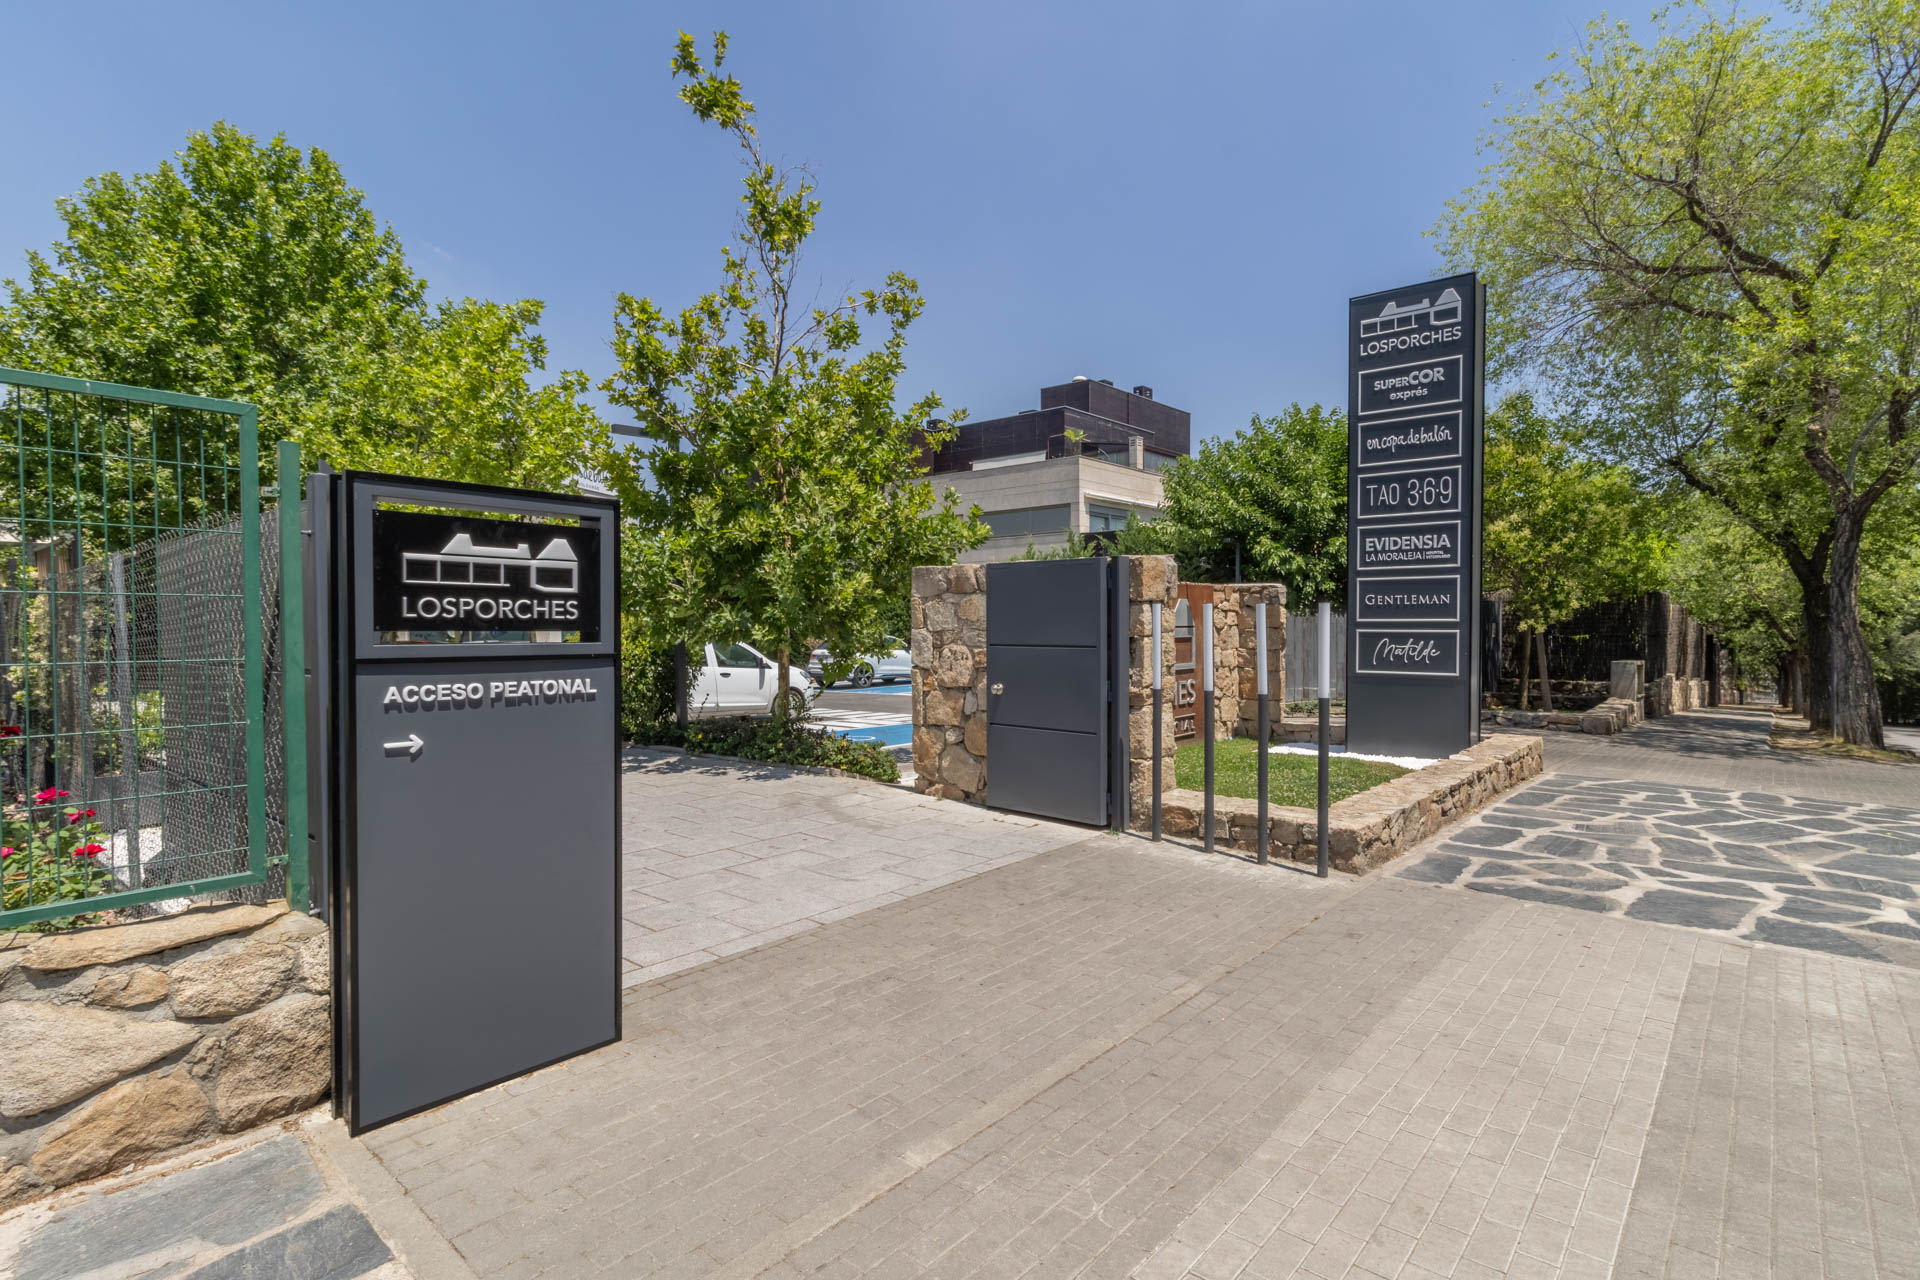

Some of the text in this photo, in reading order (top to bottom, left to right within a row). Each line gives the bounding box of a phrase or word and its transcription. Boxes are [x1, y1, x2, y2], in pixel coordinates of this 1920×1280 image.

[1360, 326, 1462, 356] LOSPORCHES
[1374, 367, 1445, 391] SUPERCOR
[1389, 386, 1428, 401] exprés
[1366, 483, 1400, 507] TAO
[1365, 534, 1451, 552] EVIDENSIA
[1365, 553, 1376, 562] LA
[1377, 551, 1422, 561] MORALEJA
[401, 596, 579, 620] LOSPORCHES
[1372, 637, 1441, 665] Matilde
[383, 678, 597, 704] ACCESO PEATONAL
